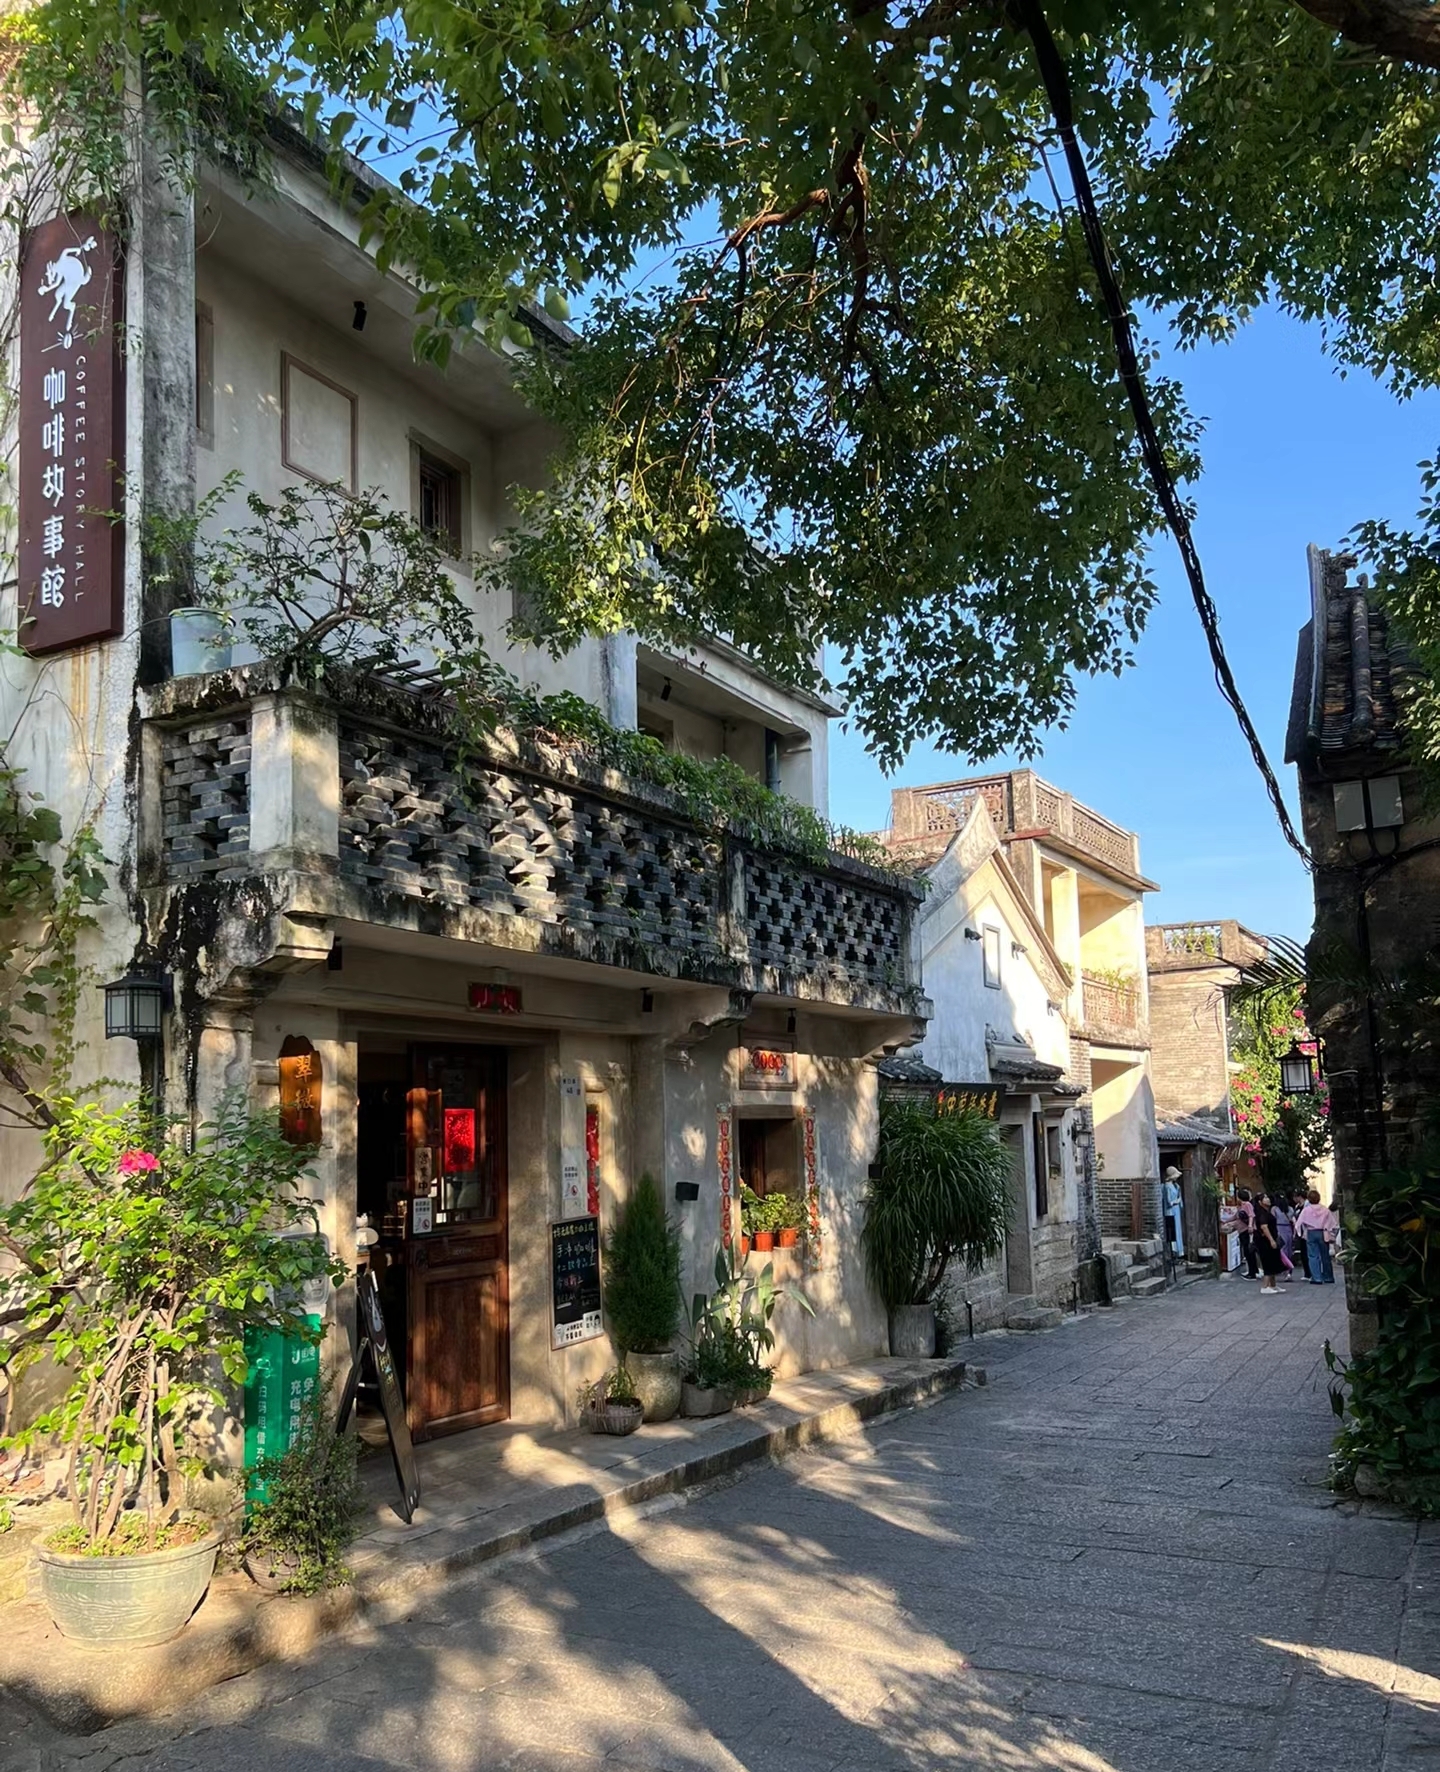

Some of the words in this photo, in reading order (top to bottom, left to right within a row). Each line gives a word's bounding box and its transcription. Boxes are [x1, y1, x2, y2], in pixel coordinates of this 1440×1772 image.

[75, 355, 86, 443] COFFEE
[42, 366, 66, 608] 咖啡故事館
[75, 456, 86, 530] STORY
[75, 544, 85, 602] HALL
